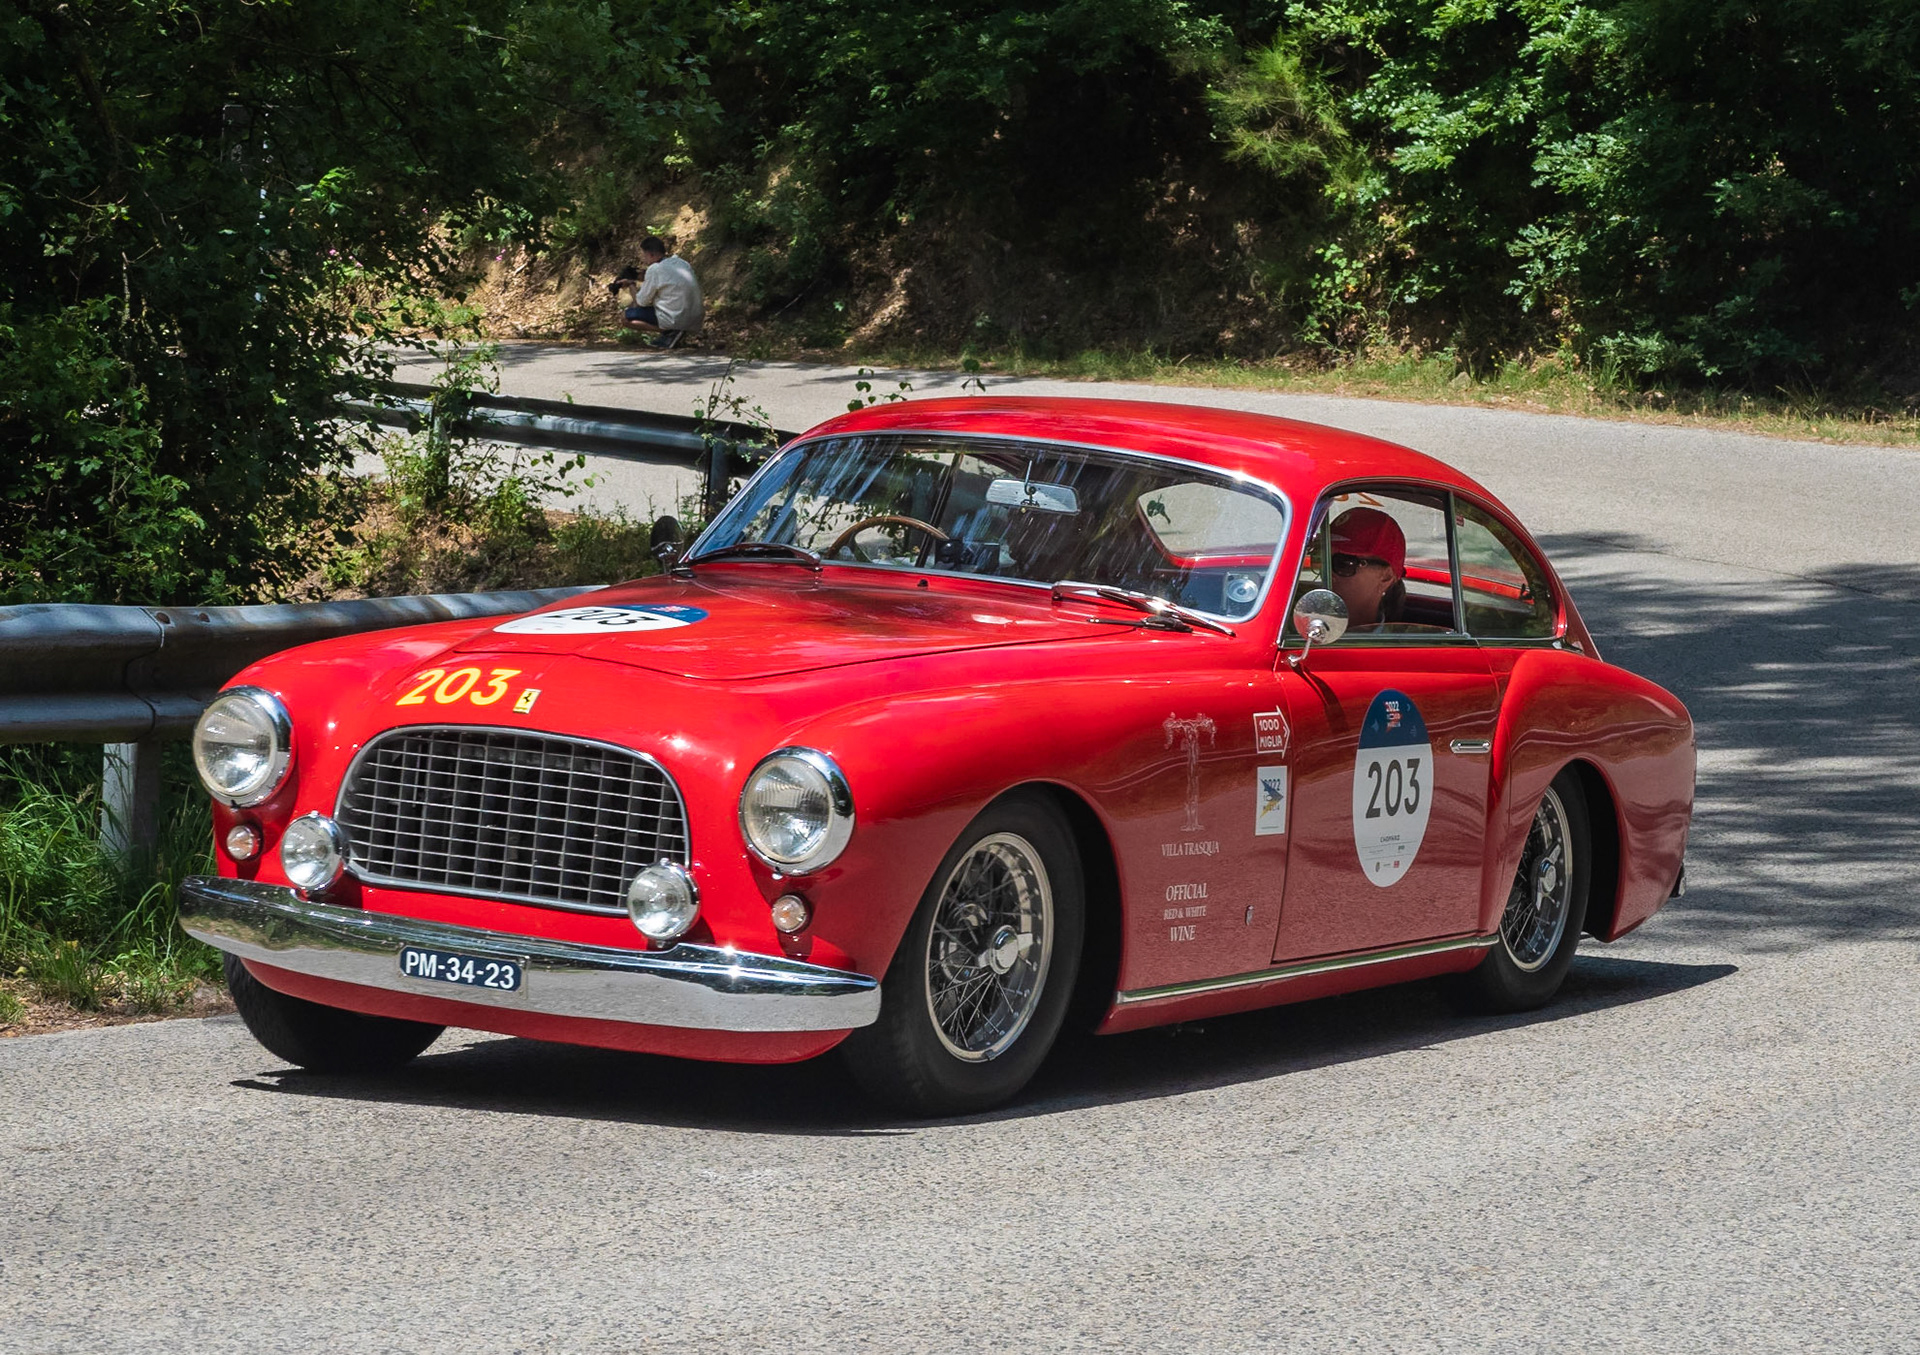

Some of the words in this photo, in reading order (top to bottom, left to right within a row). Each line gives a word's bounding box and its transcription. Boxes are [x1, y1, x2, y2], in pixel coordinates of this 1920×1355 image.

[543, 609, 660, 626] 203
[395, 667, 522, 705] 203
[1259, 718, 1280, 731] 1000
[1260, 735, 1283, 748] MIGLIA
[1365, 758, 1420, 819] 203
[1161, 843, 1184, 856] VILLA
[1184, 841, 1220, 856] TRASQUA
[1165, 882, 1208, 902] OFFICIAL
[1163, 908, 1177, 920] RED
[1177, 907, 1184, 918] &
[1185, 905, 1206, 917] WHITE
[1170, 925, 1196, 942] WINE
[405, 950, 515, 989] PM-34-23
